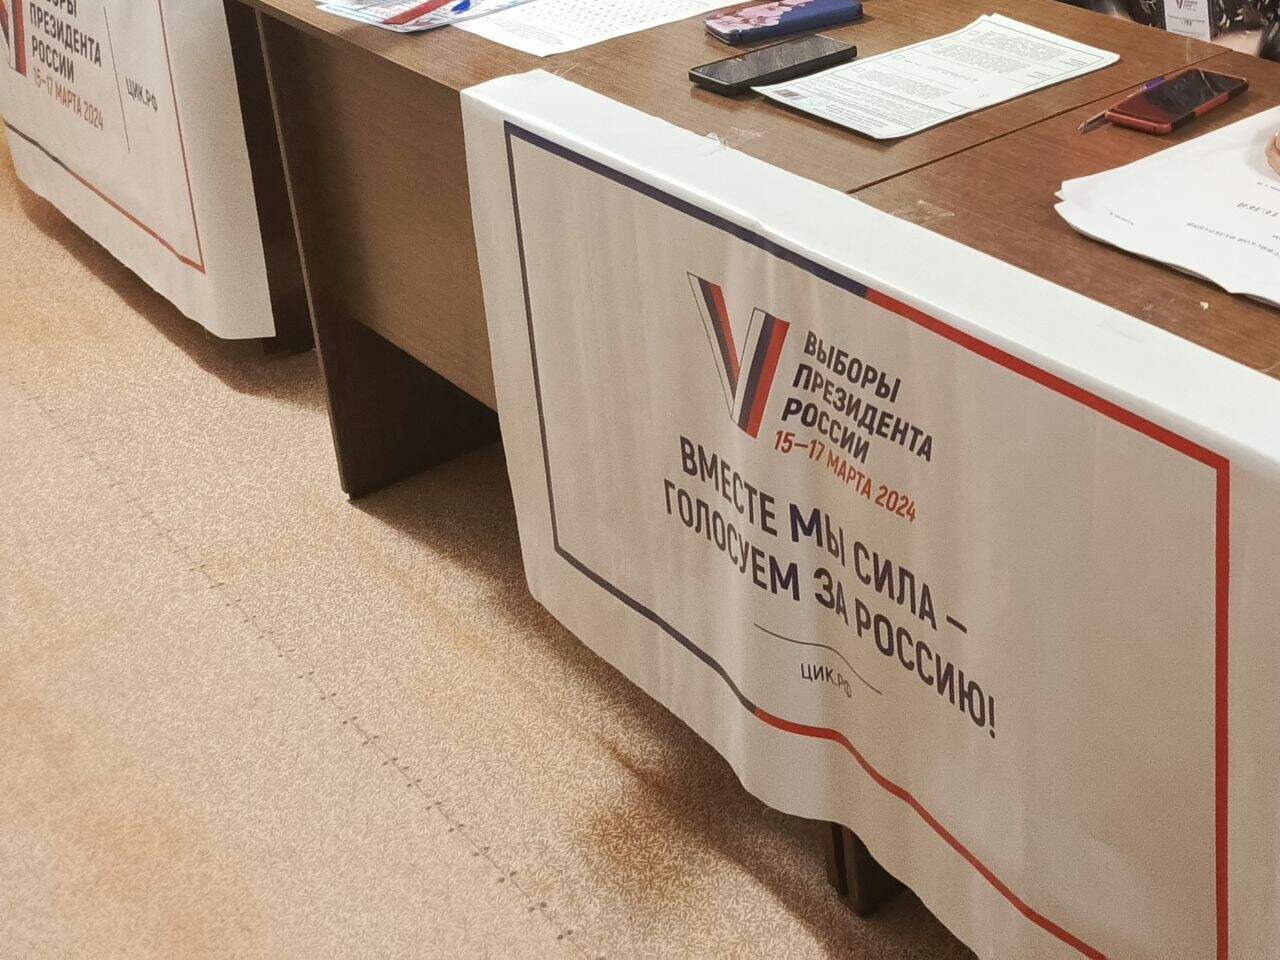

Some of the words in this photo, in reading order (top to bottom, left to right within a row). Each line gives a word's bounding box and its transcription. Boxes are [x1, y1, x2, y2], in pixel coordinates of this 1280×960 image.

[29, 1, 102, 68] ПРЕЗИДЕНТА
[31, 34, 75, 84] РОССИИ
[55, 82, 82, 116] МАРТА
[84, 100, 104, 131] 2024
[125, 75, 158, 113] ЦИК.РФ
[803, 330, 902, 403] ВЫБОРЫ
[780, 397, 871, 464] РОССИИ
[792, 362, 934, 463] ПРЕЗИДЕНТА
[826, 449, 874, 500] МАРТА
[874, 485, 917, 523] 2024
[679, 435, 778, 537] ВМЕСТЕ
[789, 503, 846, 568] МЫ
[853, 541, 938, 632] СИЛА
[664, 478, 801, 602] ГОЛОСУЕМ
[813, 567, 850, 626] ЗА
[854, 597, 997, 739] РОССИЮ!
[801, 663, 852, 698] ЦИК.РФ
